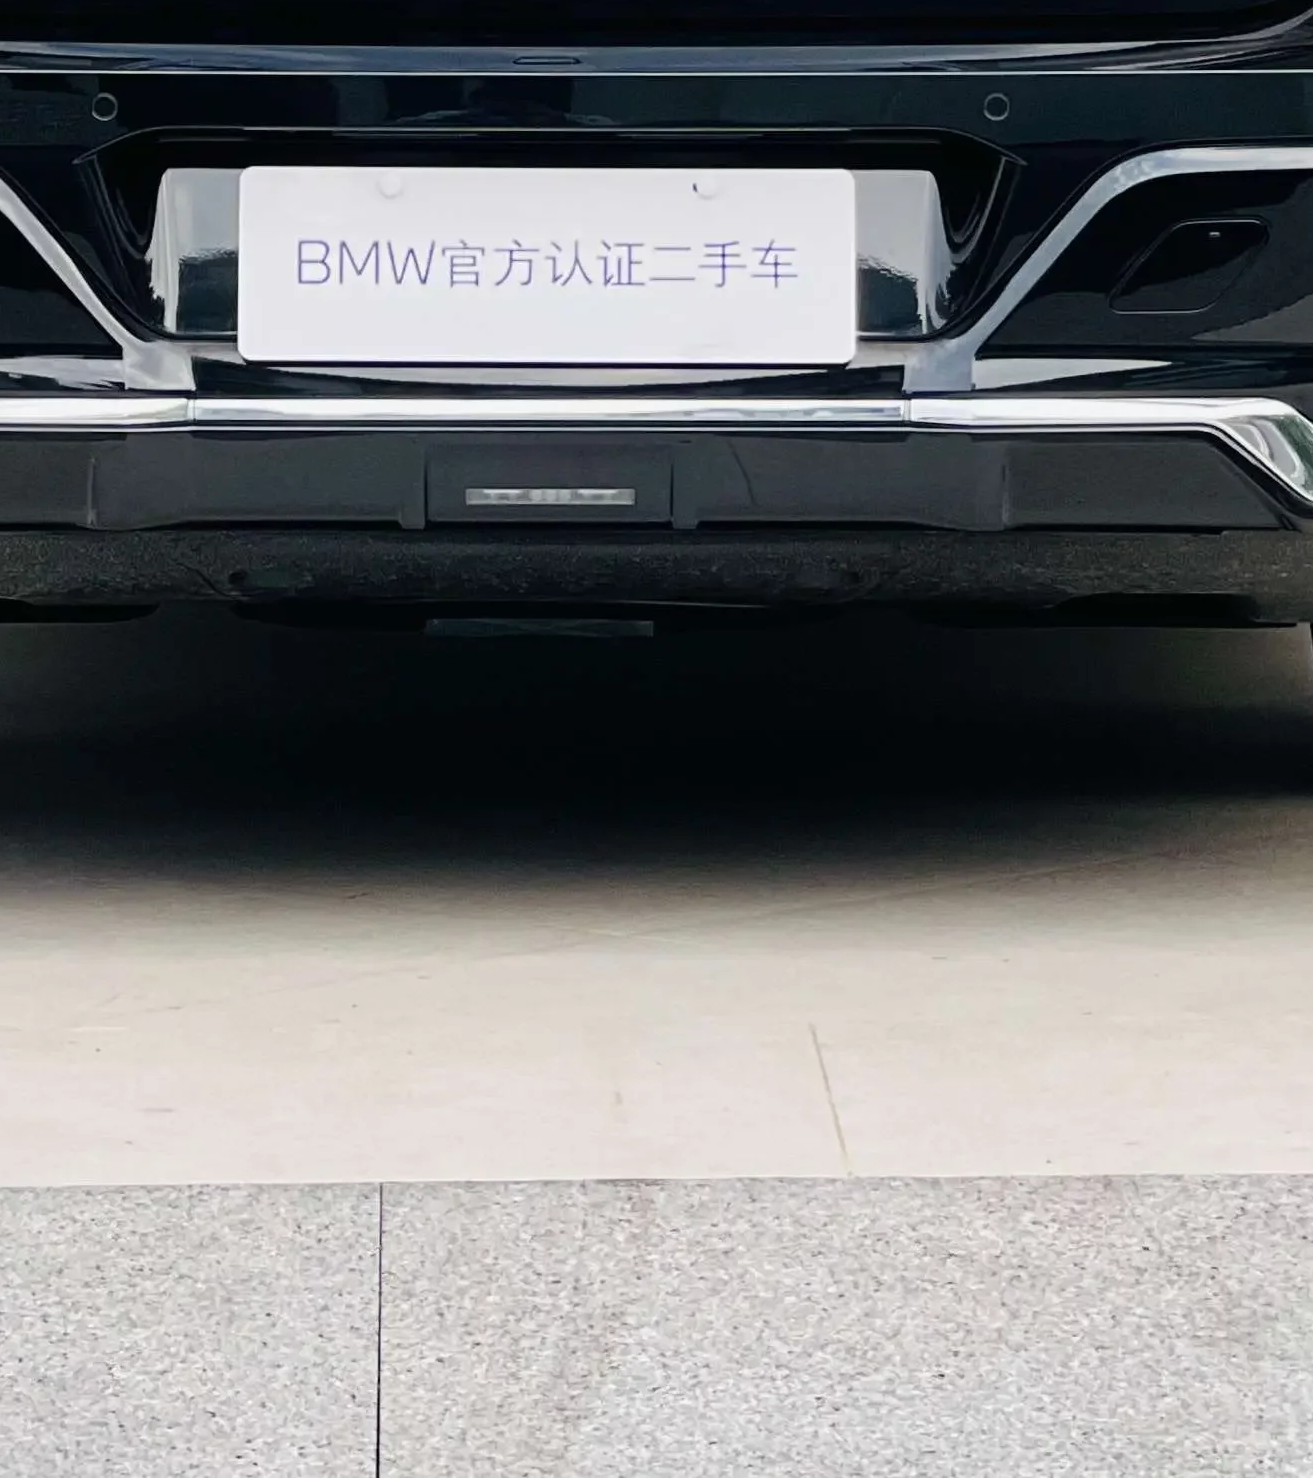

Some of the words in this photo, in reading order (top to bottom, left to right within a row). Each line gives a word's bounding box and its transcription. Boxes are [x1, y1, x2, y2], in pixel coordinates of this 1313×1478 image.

[296, 238, 800, 289] BMW官方认证二手车
